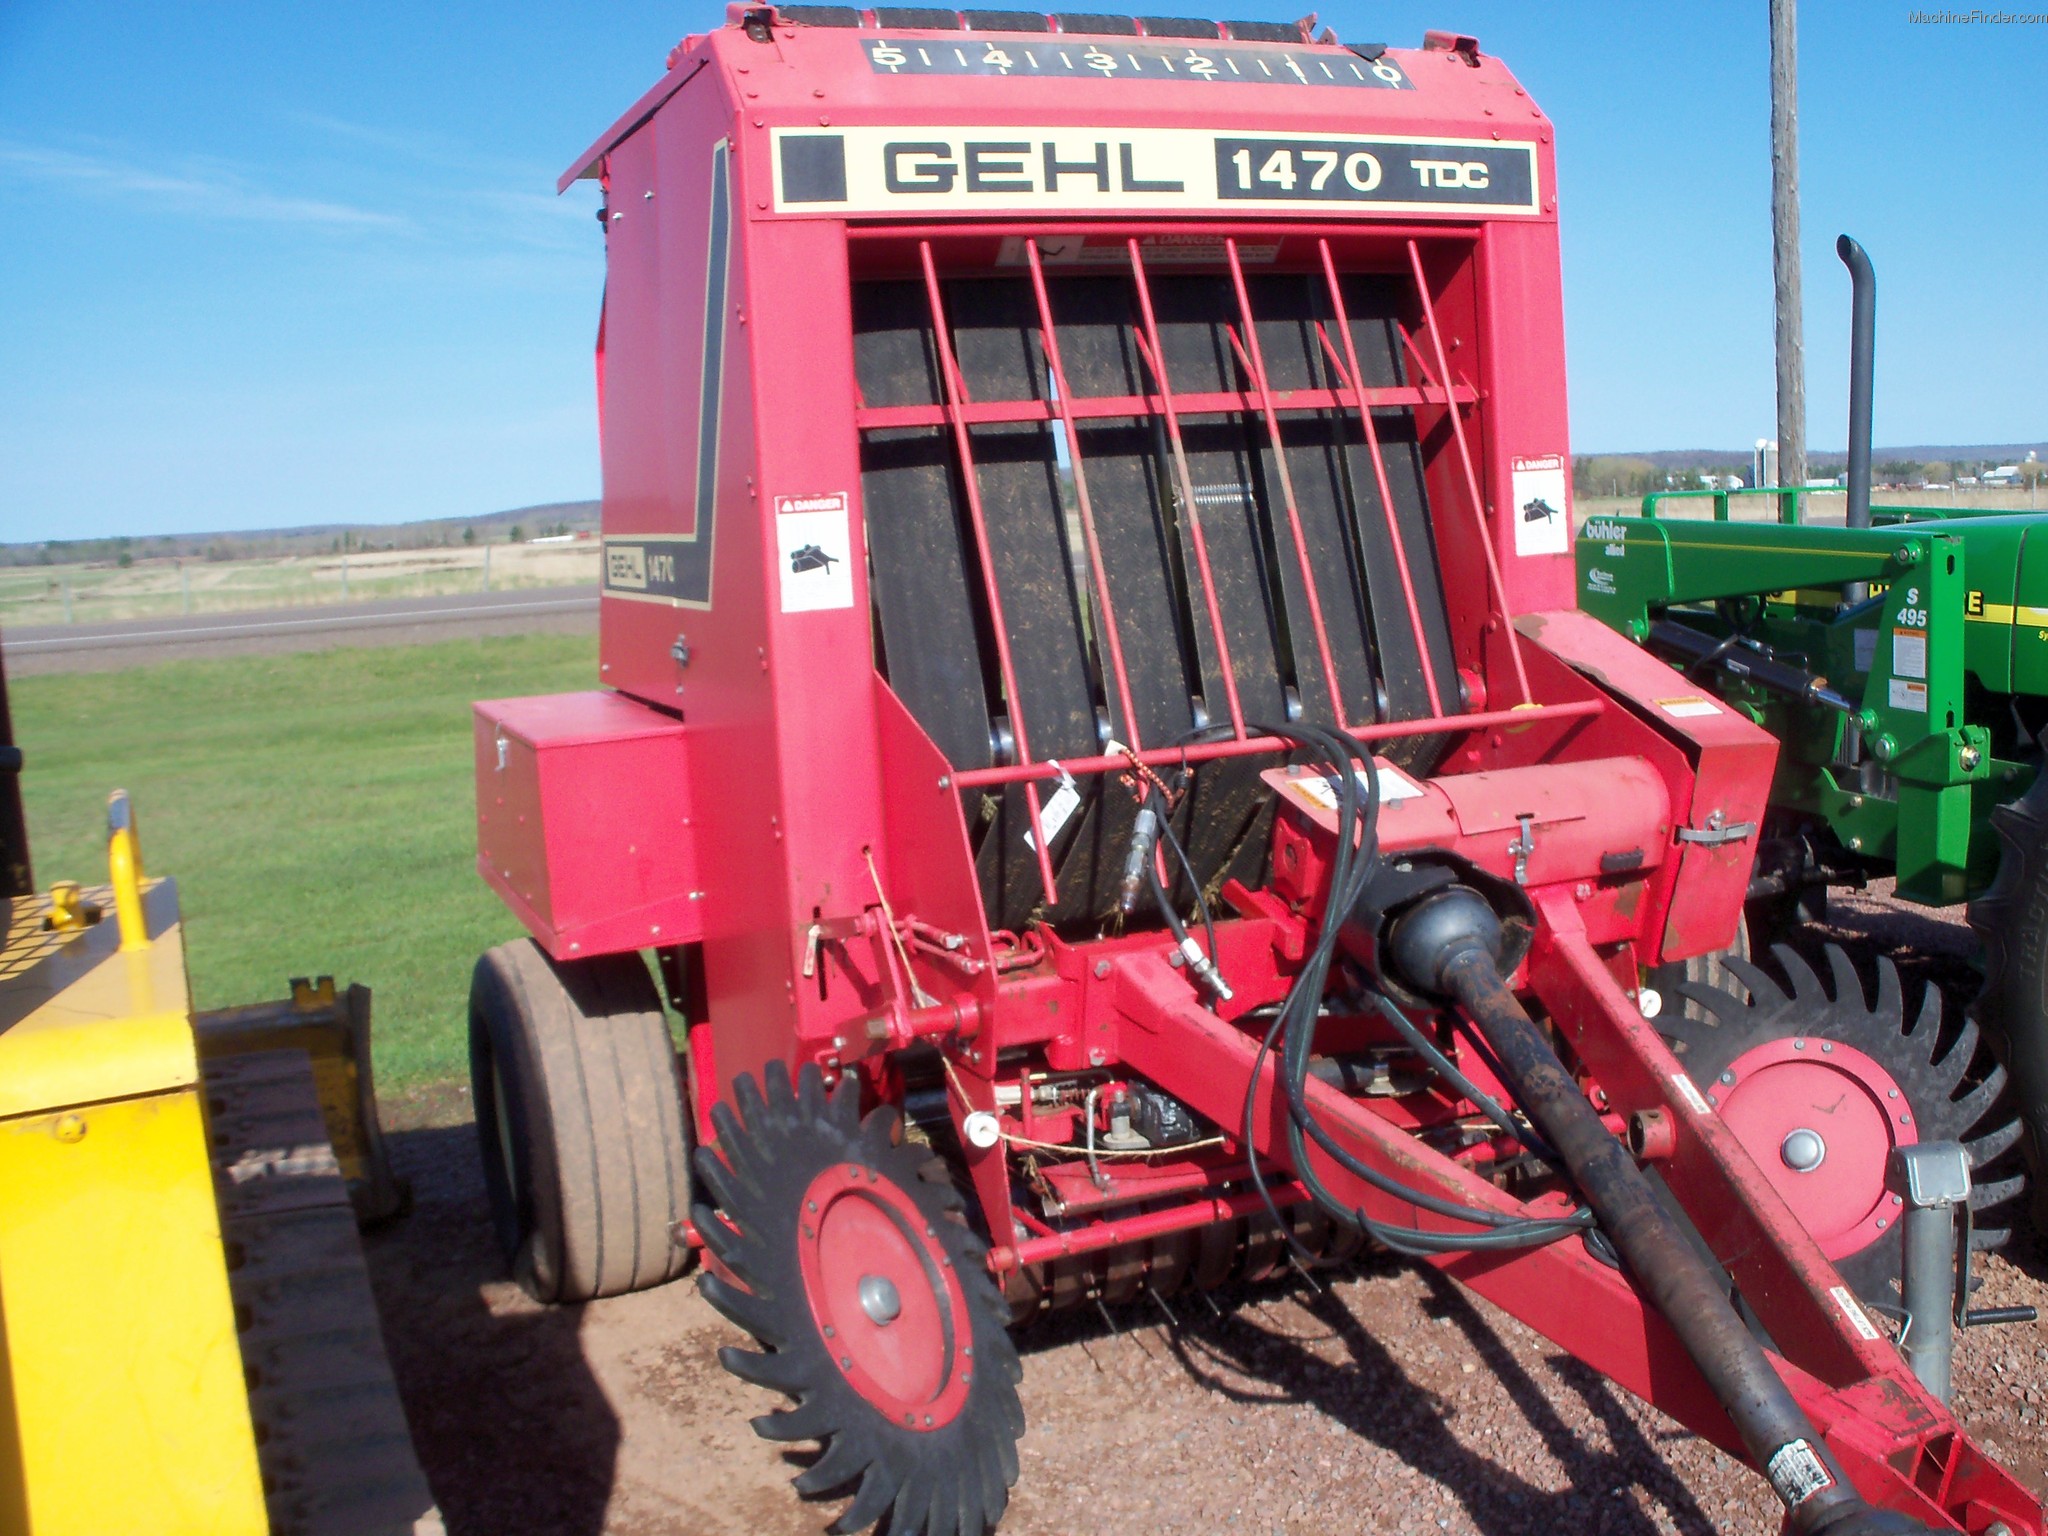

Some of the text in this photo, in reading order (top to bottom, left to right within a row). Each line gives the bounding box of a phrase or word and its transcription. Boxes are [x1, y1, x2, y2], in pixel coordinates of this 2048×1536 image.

[871, 47, 907, 66] 5
[982, 50, 1013, 68] 4
[1083, 52, 1118, 70] 3
[1184, 56, 1219, 75] 2
[1371, 64, 1402, 83] 0
[883, 142, 1489, 193] GEHL 1470 TDC
[1524, 458, 1560, 470] DANGER
[793, 498, 841, 512] DANGER
[1586, 520, 1627, 540] bühler
[1906, 587, 1919, 605] S
[1897, 608, 1927, 627] 495
